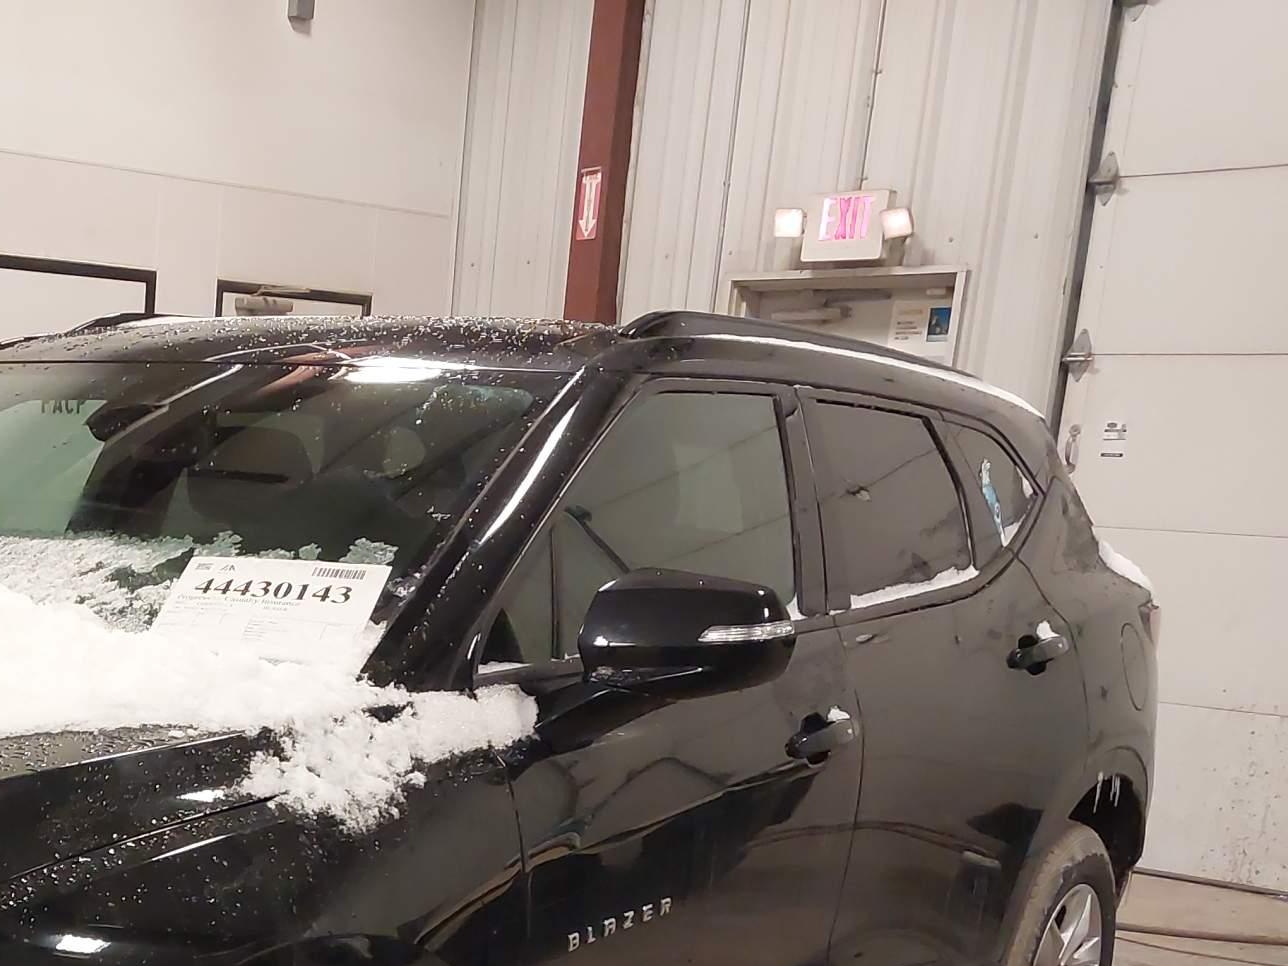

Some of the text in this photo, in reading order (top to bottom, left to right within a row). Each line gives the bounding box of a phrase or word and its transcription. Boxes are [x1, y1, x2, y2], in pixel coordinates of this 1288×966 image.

[818, 196, 872, 241] EXIT
[194, 577, 353, 604] 44430143
[567, 897, 672, 952] BLAZER
